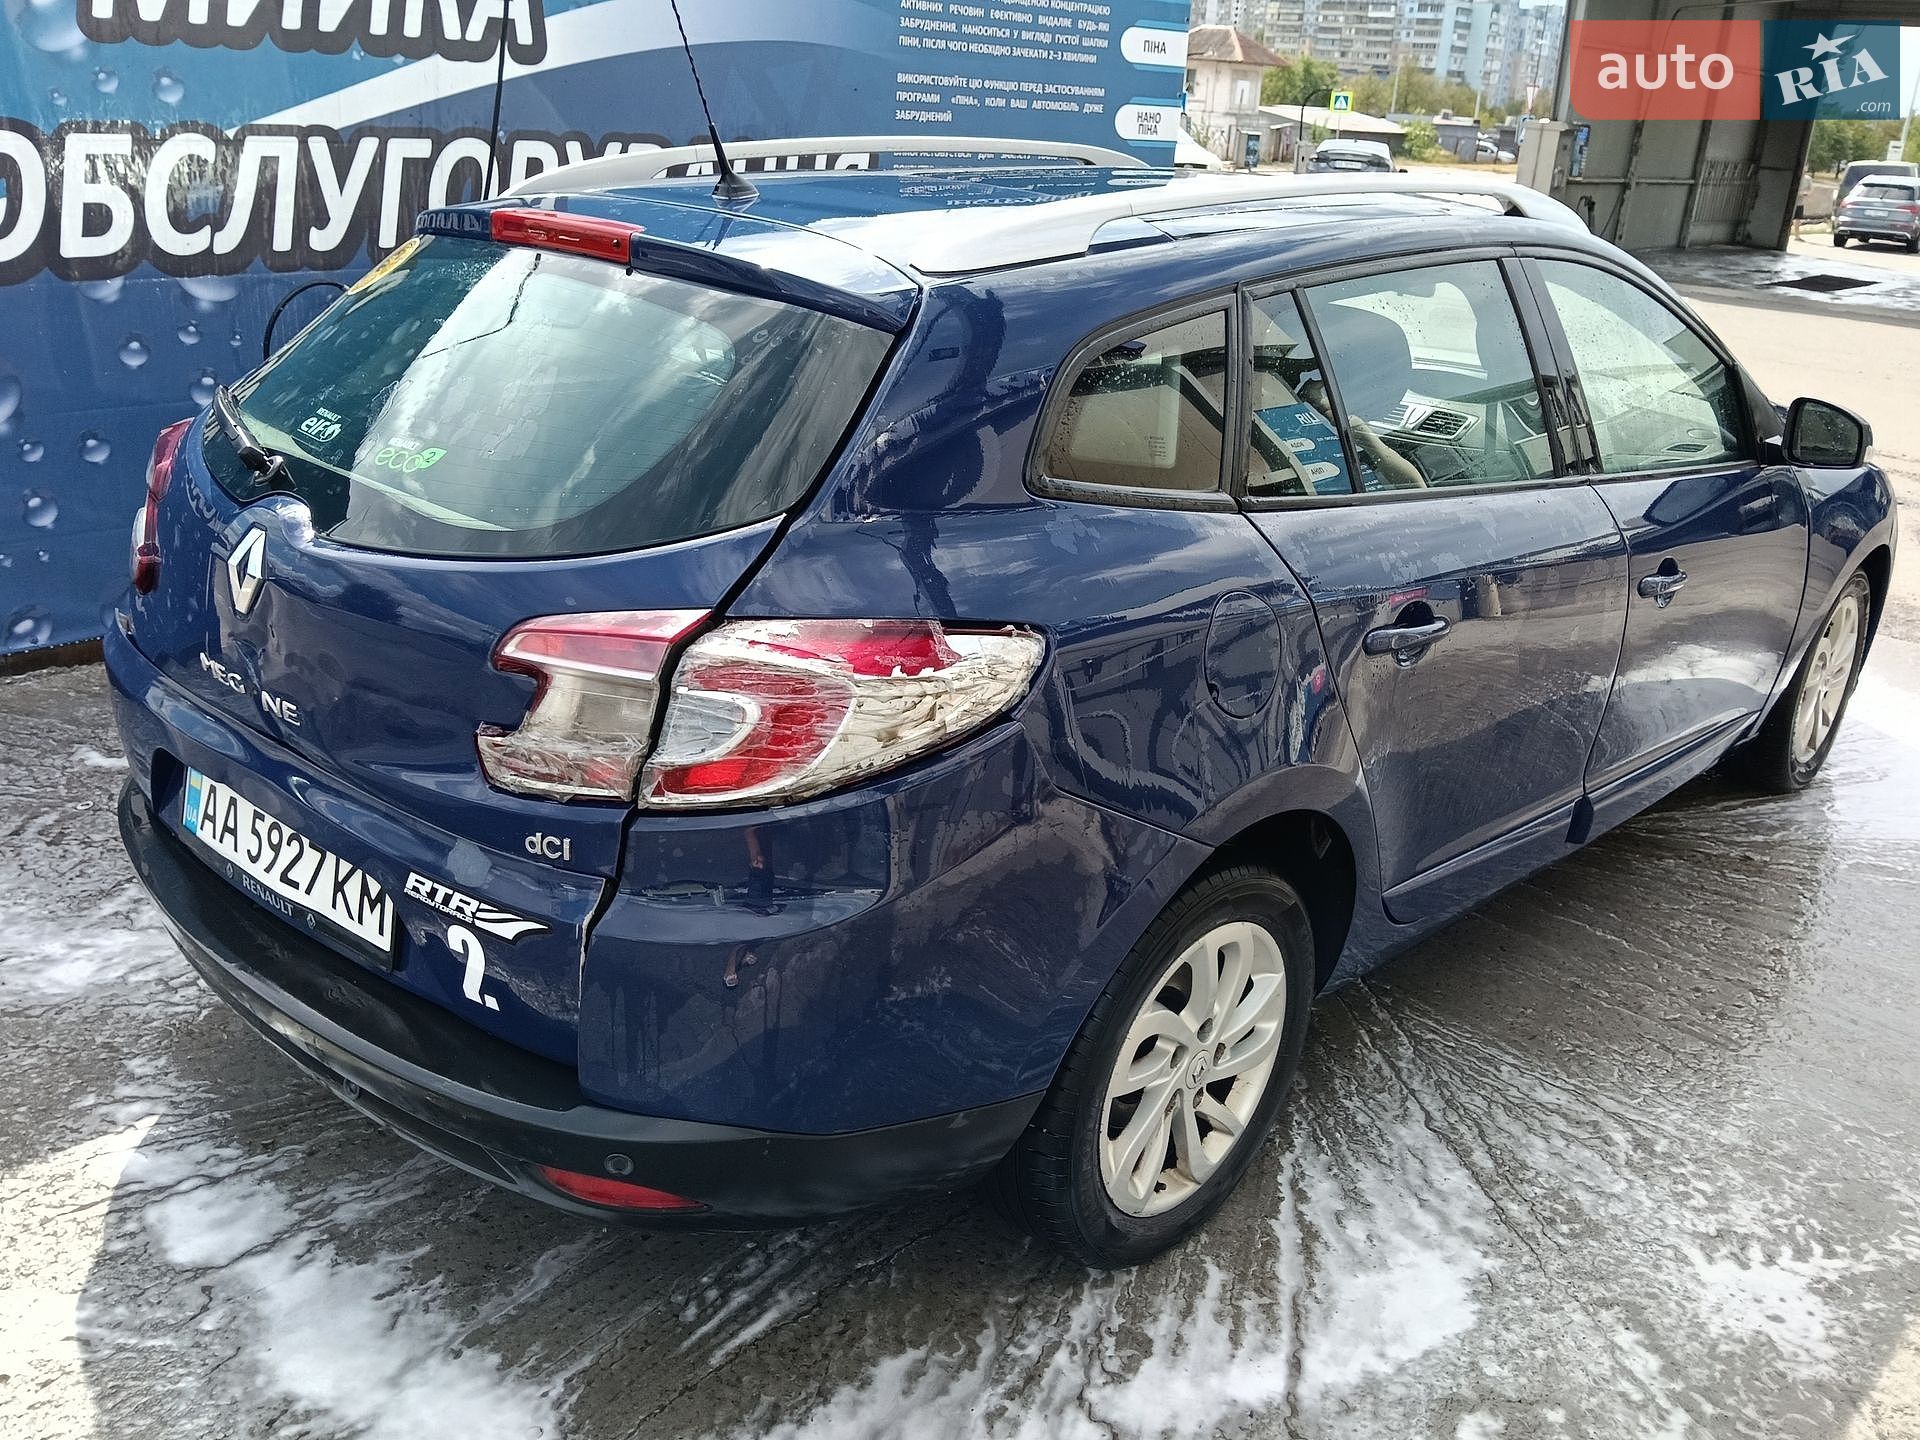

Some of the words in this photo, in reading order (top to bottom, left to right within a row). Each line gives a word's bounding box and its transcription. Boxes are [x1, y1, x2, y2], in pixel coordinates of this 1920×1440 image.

[901, 0, 943, 13] АКТИВНИХ
[949, 4, 984, 18] РЕЧОВИН
[990, 9, 1033, 23] ЕФЕКТИВНО
[1038, 15, 1072, 28] ВИДАЛЯЄ
[899, 16, 958, 33] ЗАБРУДНЕННЯ.
[962, 24, 1010, 39] НАНОСИТЬСЯ
[1013, 30, 1019, 39] У
[1021, 31, 1052, 44] ВИГЛЯДІ
[1055, 34, 1080, 45] ГУСТОЇ
[1082, 37, 1109, 48] ШАПКИ
[899, 35, 921, 48] ПІНИ,
[922, 38, 946, 50] ПІСЛЯ
[947, 39, 968, 51] ЧОГО
[969, 42, 1011, 56] НЕОБХІДНО
[1012, 46, 1048, 59] ЗАЧЕКАТИ
[1062, 52, 1097, 63] ХВИЛИНИ
[1143, 40, 1167, 54] ПІНА
[897, 72, 968, 88] ВИКОРИСТОВУЙТЕ
[969, 78, 982, 90] ЦЮ
[983, 80, 1019, 92] ФУНКЦІЮ
[1020, 82, 1042, 95] ПЕРЕД
[1044, 83, 1105, 97] ЗАСТОСУВАННЯМ
[896, 91, 940, 103] ПРОГРАМИ
[984, 97, 1006, 107] КОЛИ
[1010, 98, 1028, 109] ВАШ
[1031, 99, 1080, 112] АВТОМОБІЛЬ
[1083, 102, 1104, 114] ДУЖЕ
[895, 110, 953, 122] ЗАБРУДНЕНИЙ
[1137, 112, 1161, 123] НАНО
[1138, 124, 1158, 135] ПІНА
[300, 416, 329, 438] elf
[186, 803, 197, 824] UA
[200, 783, 238, 853] AA
[246, 808, 327, 896] 5927
[332, 857, 387, 937] KM
[242, 874, 294, 917] RENAULT
[405, 871, 480, 918] RTR
